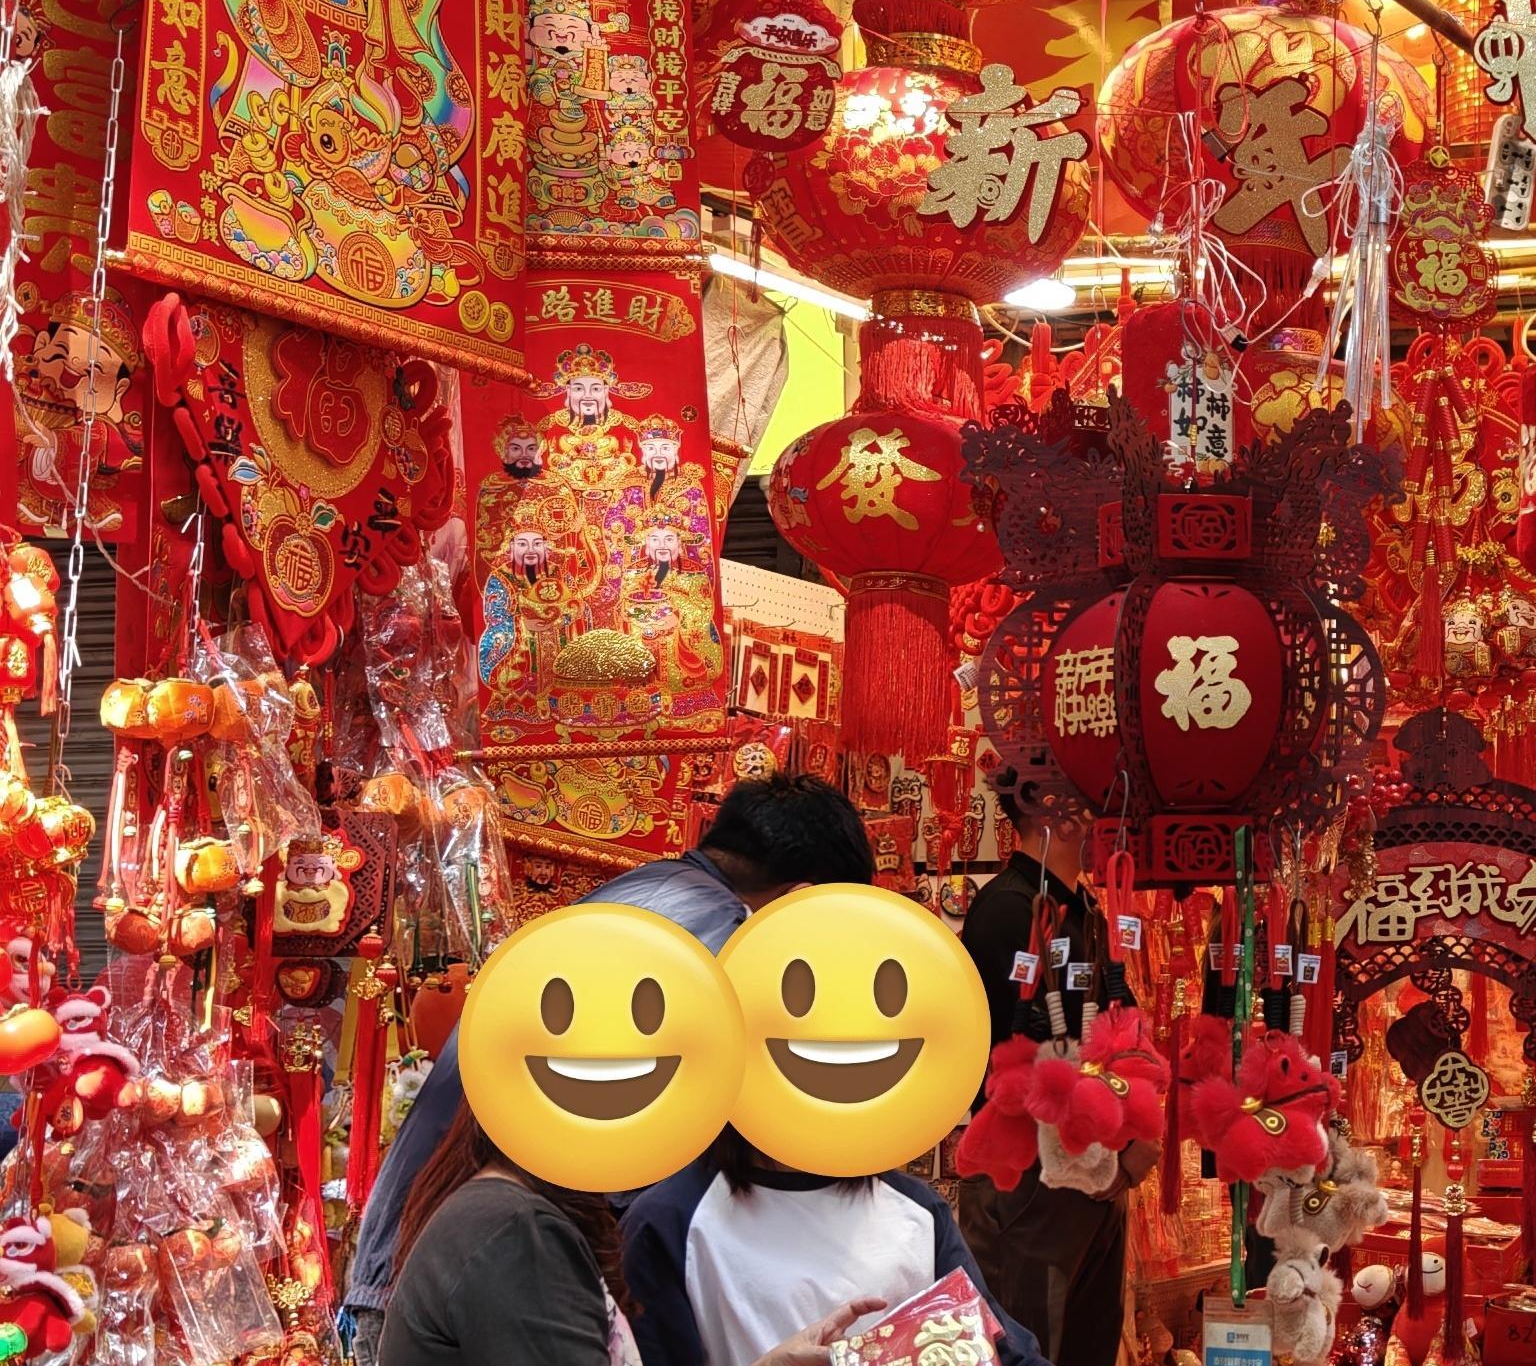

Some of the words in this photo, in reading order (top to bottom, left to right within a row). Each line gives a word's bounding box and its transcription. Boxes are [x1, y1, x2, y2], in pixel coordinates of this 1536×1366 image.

[740, 62, 808, 139] 福
[917, 63, 1090, 246] 新
[1212, 75, 1357, 258] 年
[526, 284, 664, 327] 路進財
[1415, 239, 1469, 296] 福
[815, 428, 943, 532] 發
[1150, 635, 1249, 732] 福
